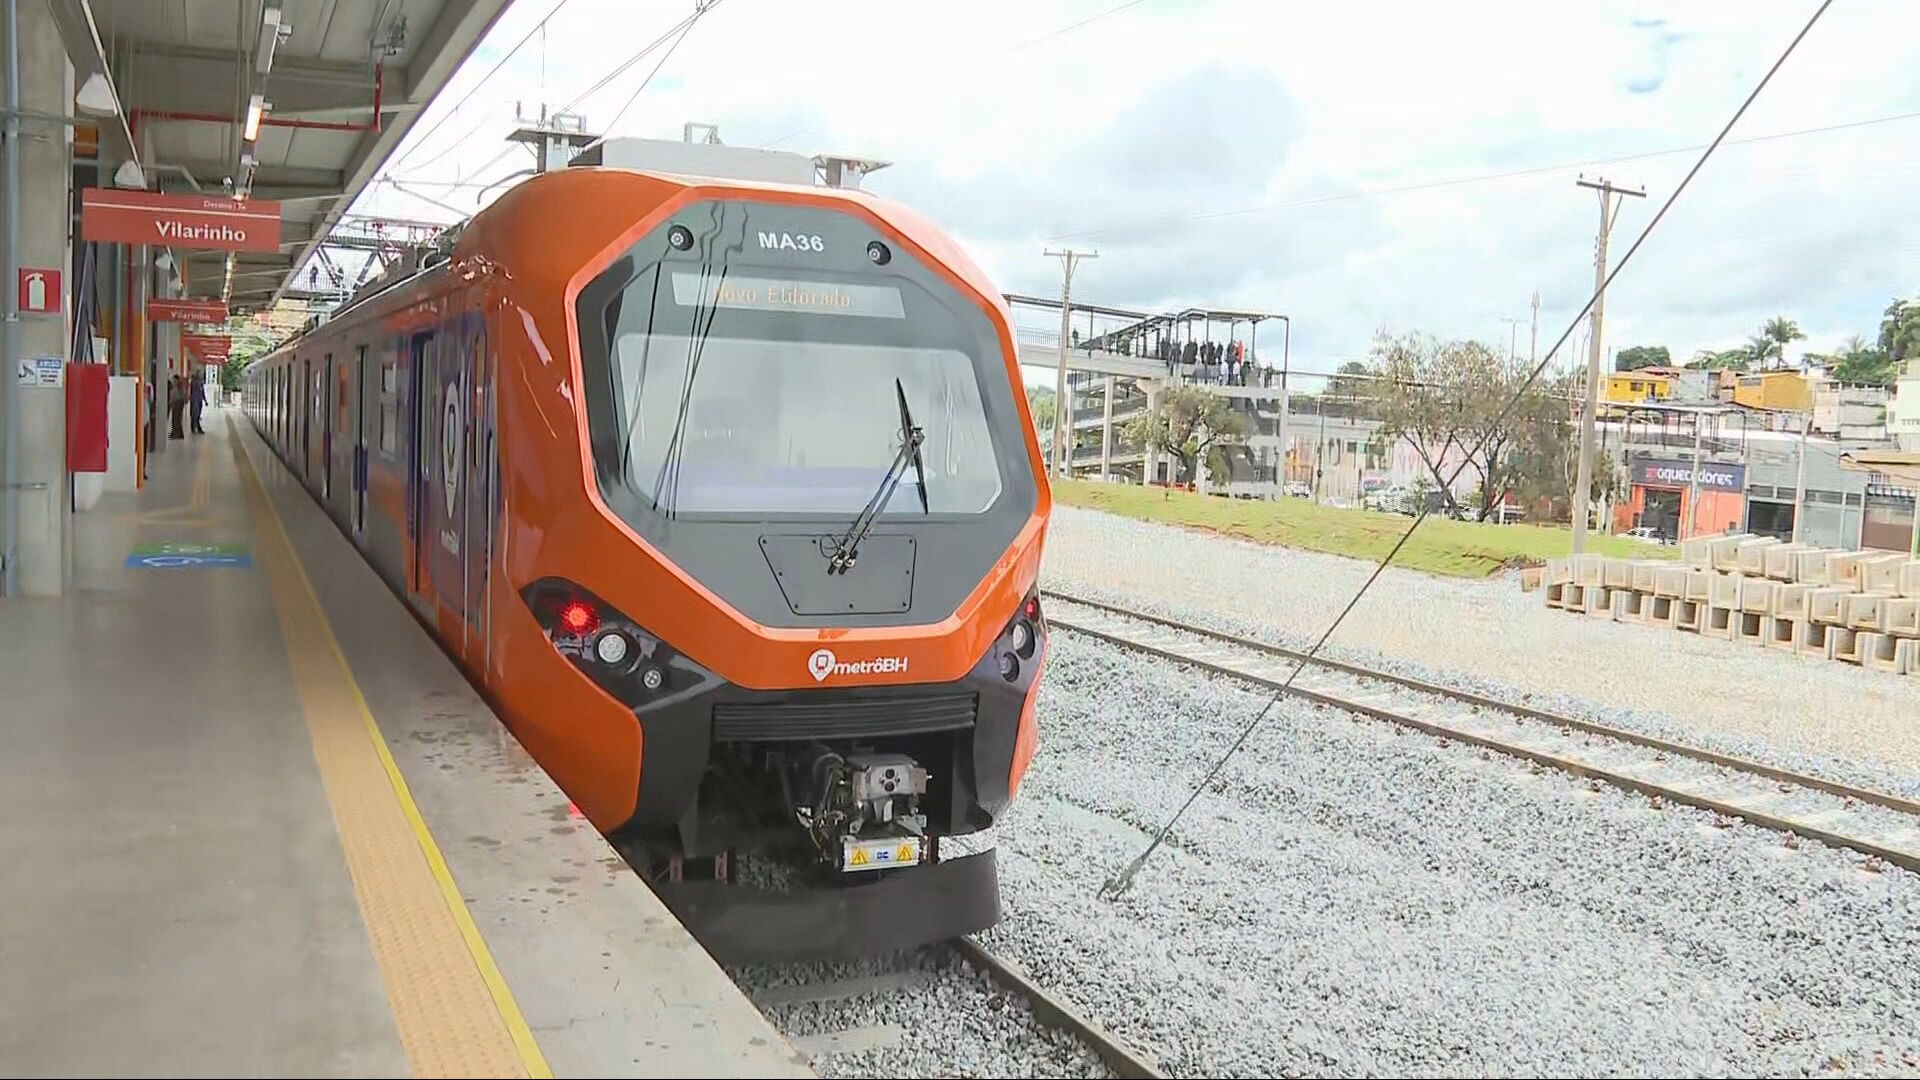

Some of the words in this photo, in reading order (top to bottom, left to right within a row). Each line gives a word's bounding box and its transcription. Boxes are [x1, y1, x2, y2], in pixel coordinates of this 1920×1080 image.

[155, 220, 246, 242] Vilarinho
[757, 231, 825, 252] MA36
[170, 310, 211, 321] Vilarinho
[833, 656, 909, 675] metrôBH
